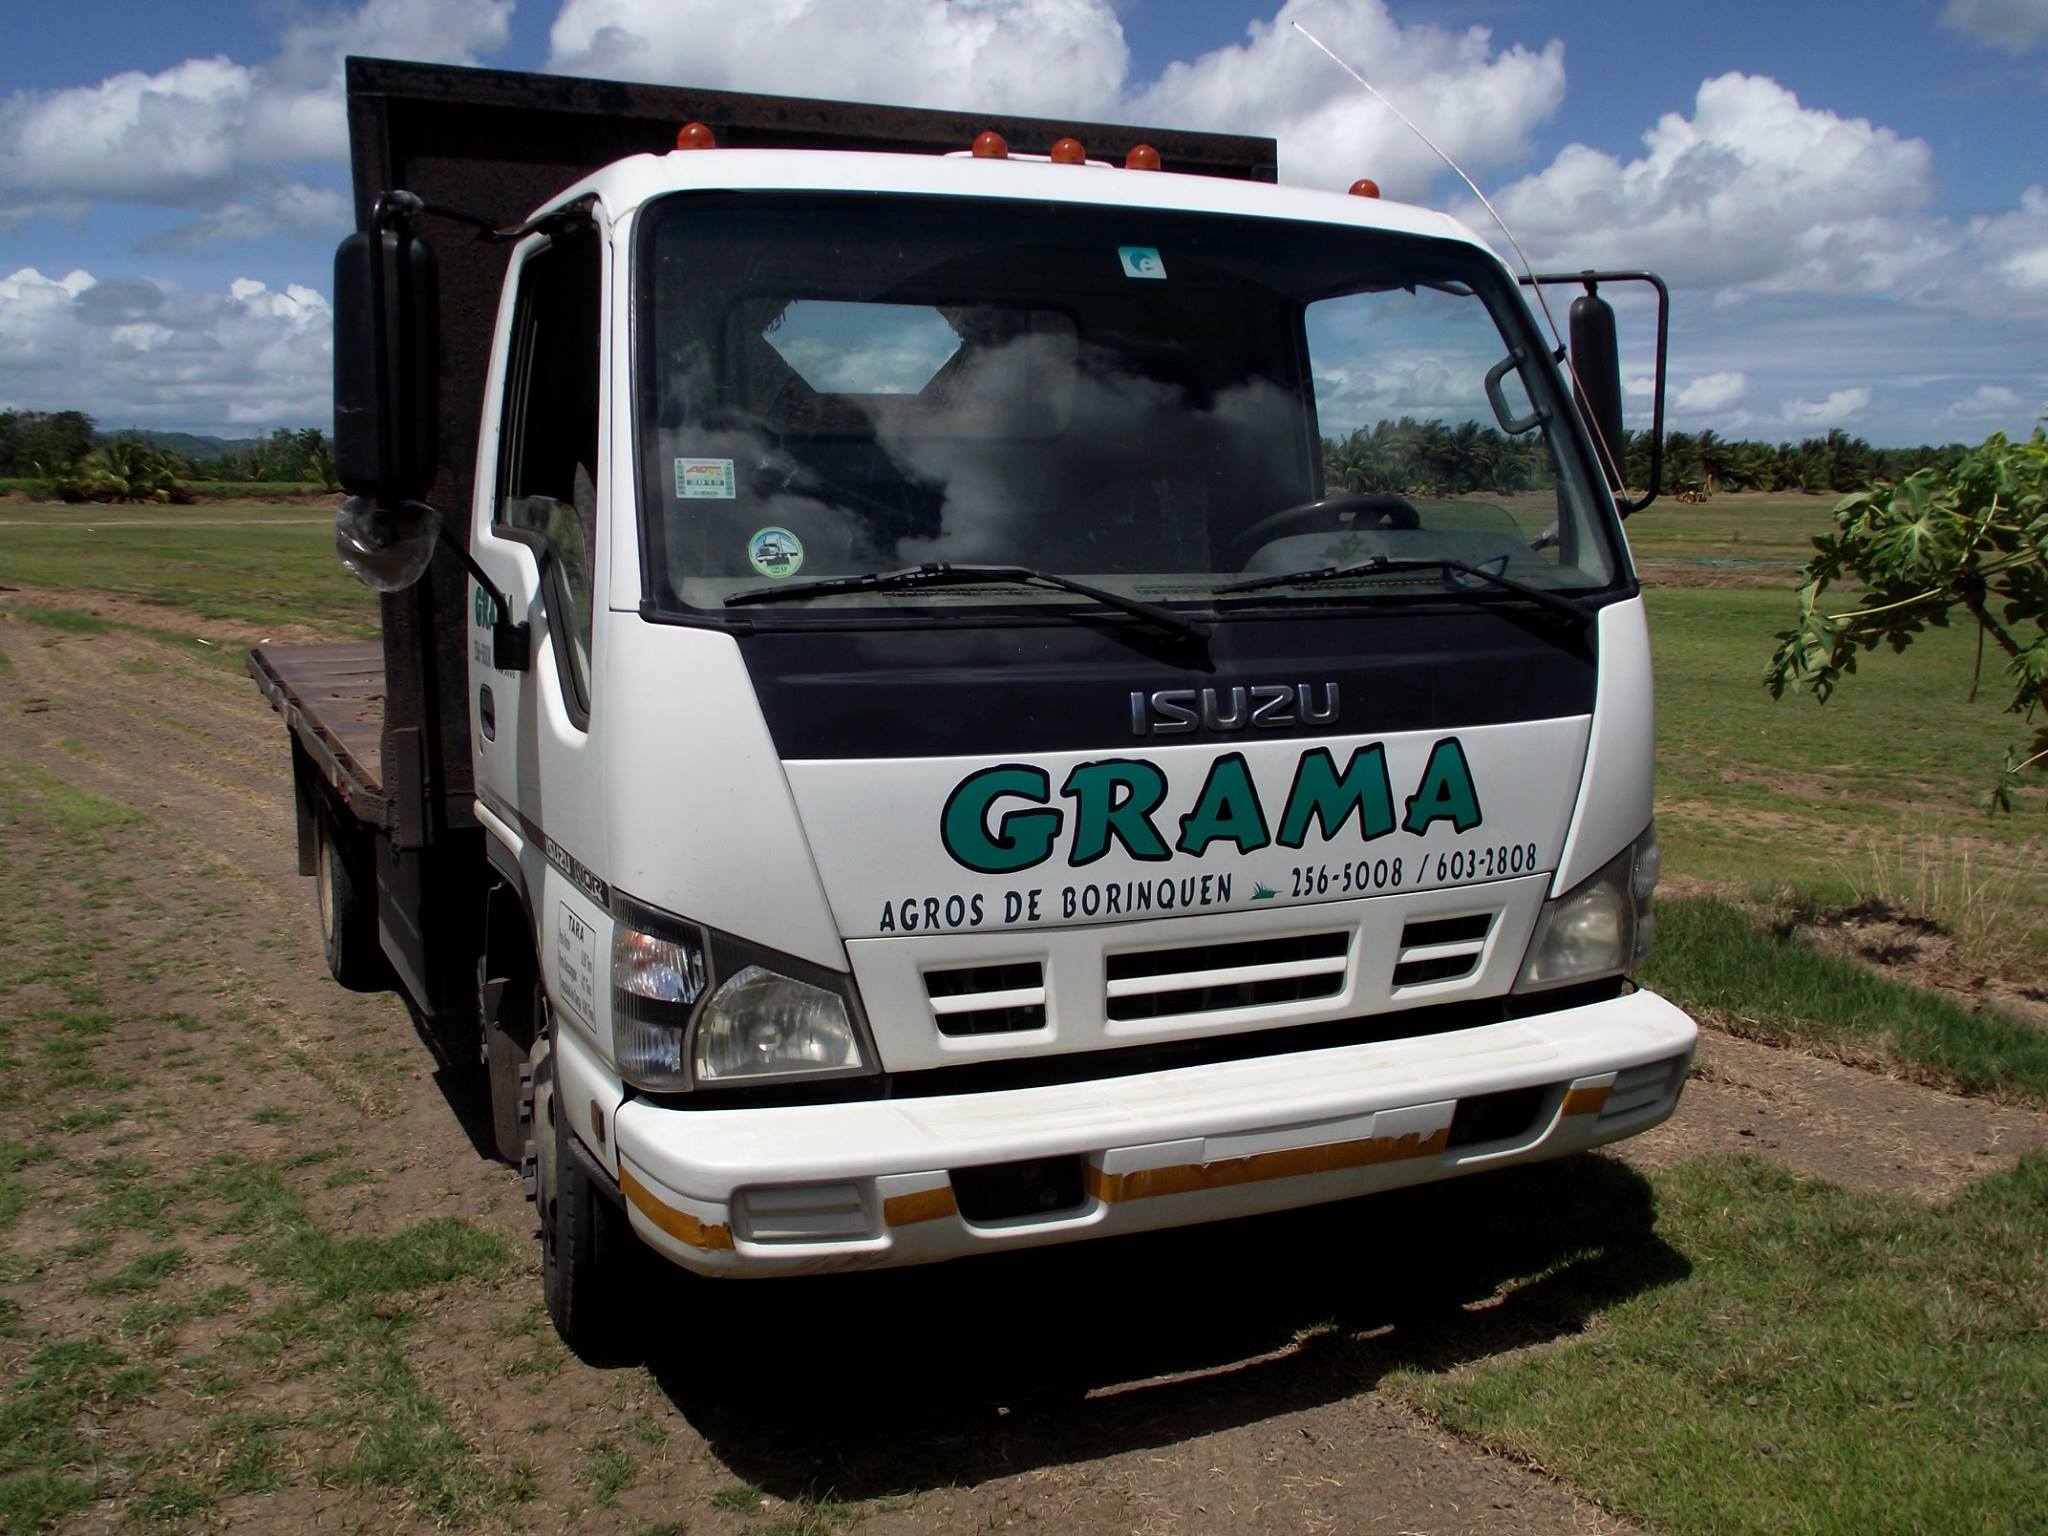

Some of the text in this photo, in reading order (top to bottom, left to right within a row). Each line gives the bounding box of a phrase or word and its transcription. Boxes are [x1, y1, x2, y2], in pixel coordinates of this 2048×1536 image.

[1129, 681, 1342, 735] ISUZU
[940, 736, 1483, 875] GRAMA
[545, 836, 571, 874] ISUZU
[880, 893, 984, 932] AGROS
[1004, 889, 1042, 924] DE
[1061, 872, 1232, 918] BORINQUEN
[1291, 857, 1402, 897] 256-5008
[1436, 843, 1537, 881] 603-2808
[568, 915, 584, 943] TARA
